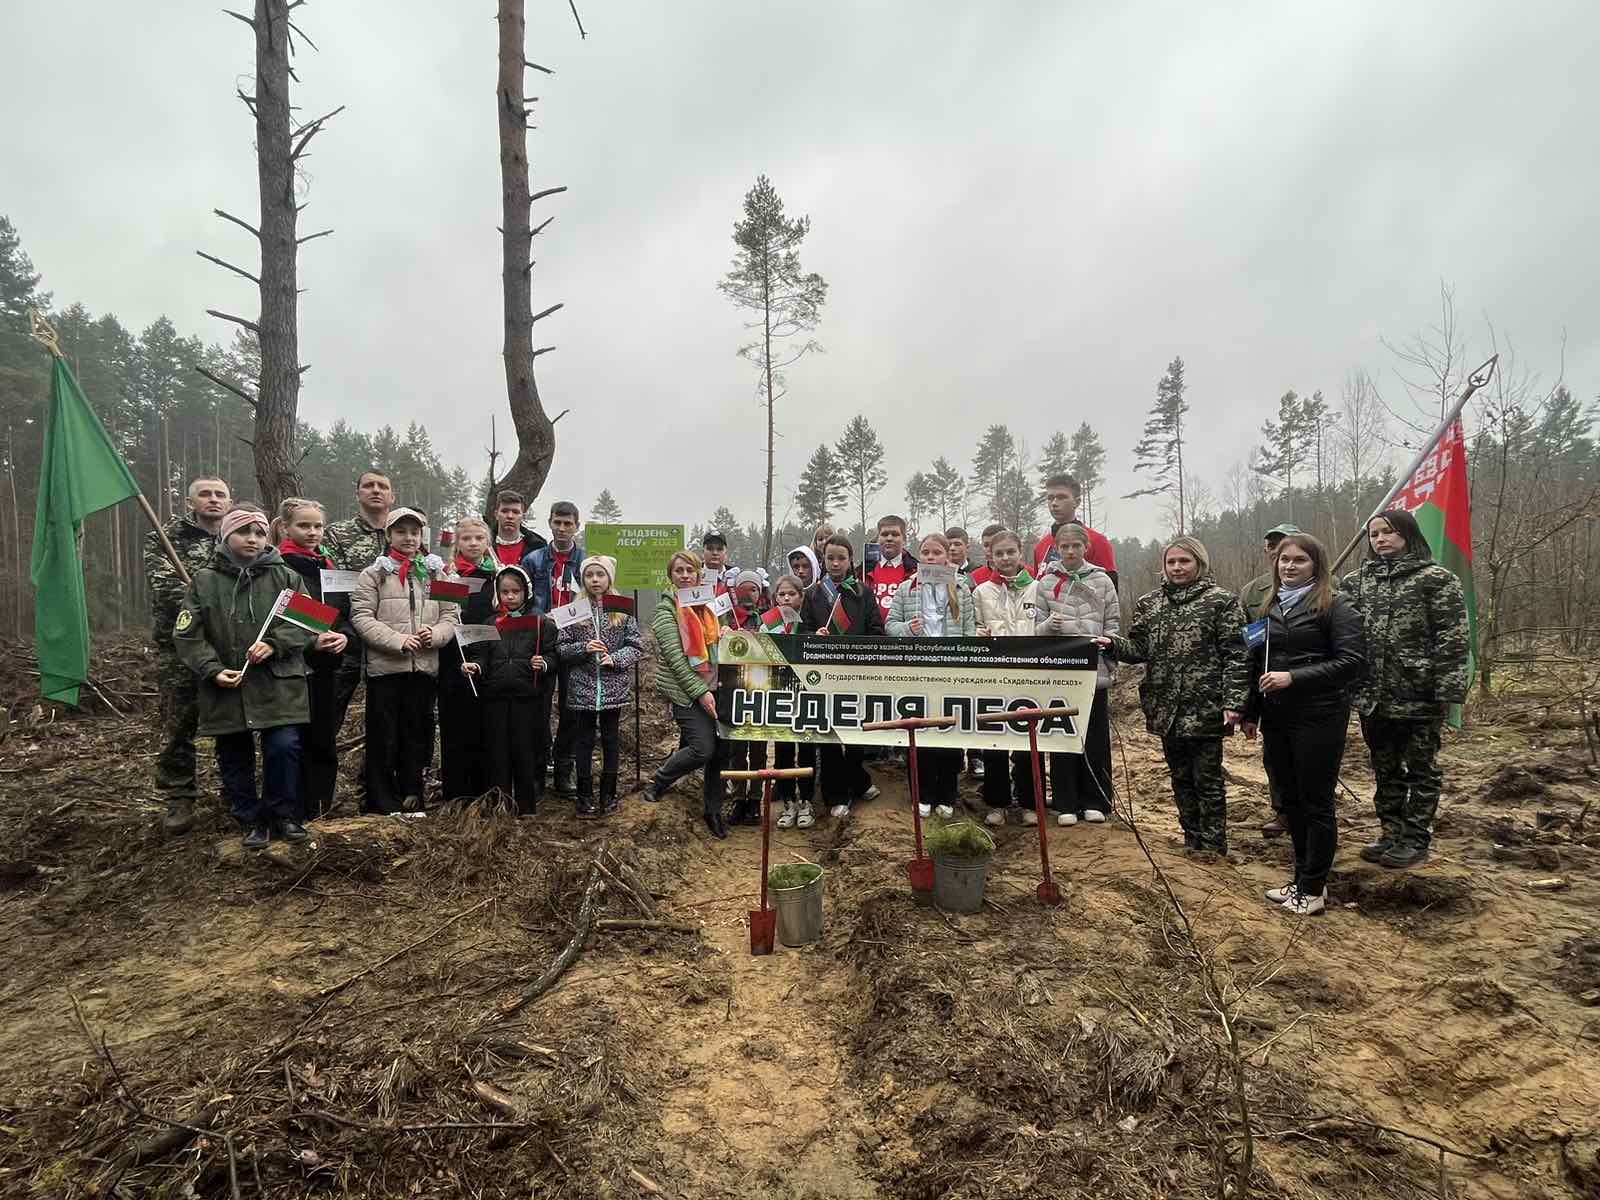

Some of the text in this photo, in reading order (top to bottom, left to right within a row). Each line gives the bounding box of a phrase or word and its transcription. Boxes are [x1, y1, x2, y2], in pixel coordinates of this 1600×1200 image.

[803, 641, 850, 651] Министерство
[879, 643, 913, 651] хозяйства
[914, 643, 955, 653] Республики
[956, 644, 990, 653] Беларусь
[803, 651, 1089, 666] Гродненское государственное производственное лесохозяйственное объединение
[824, 672, 1083, 686] Государственное лесохозяйственное учреждение «Скидельский лесхоз»
[733, 689, 1077, 736] НЕДЕЛЯ ЛЕСА
